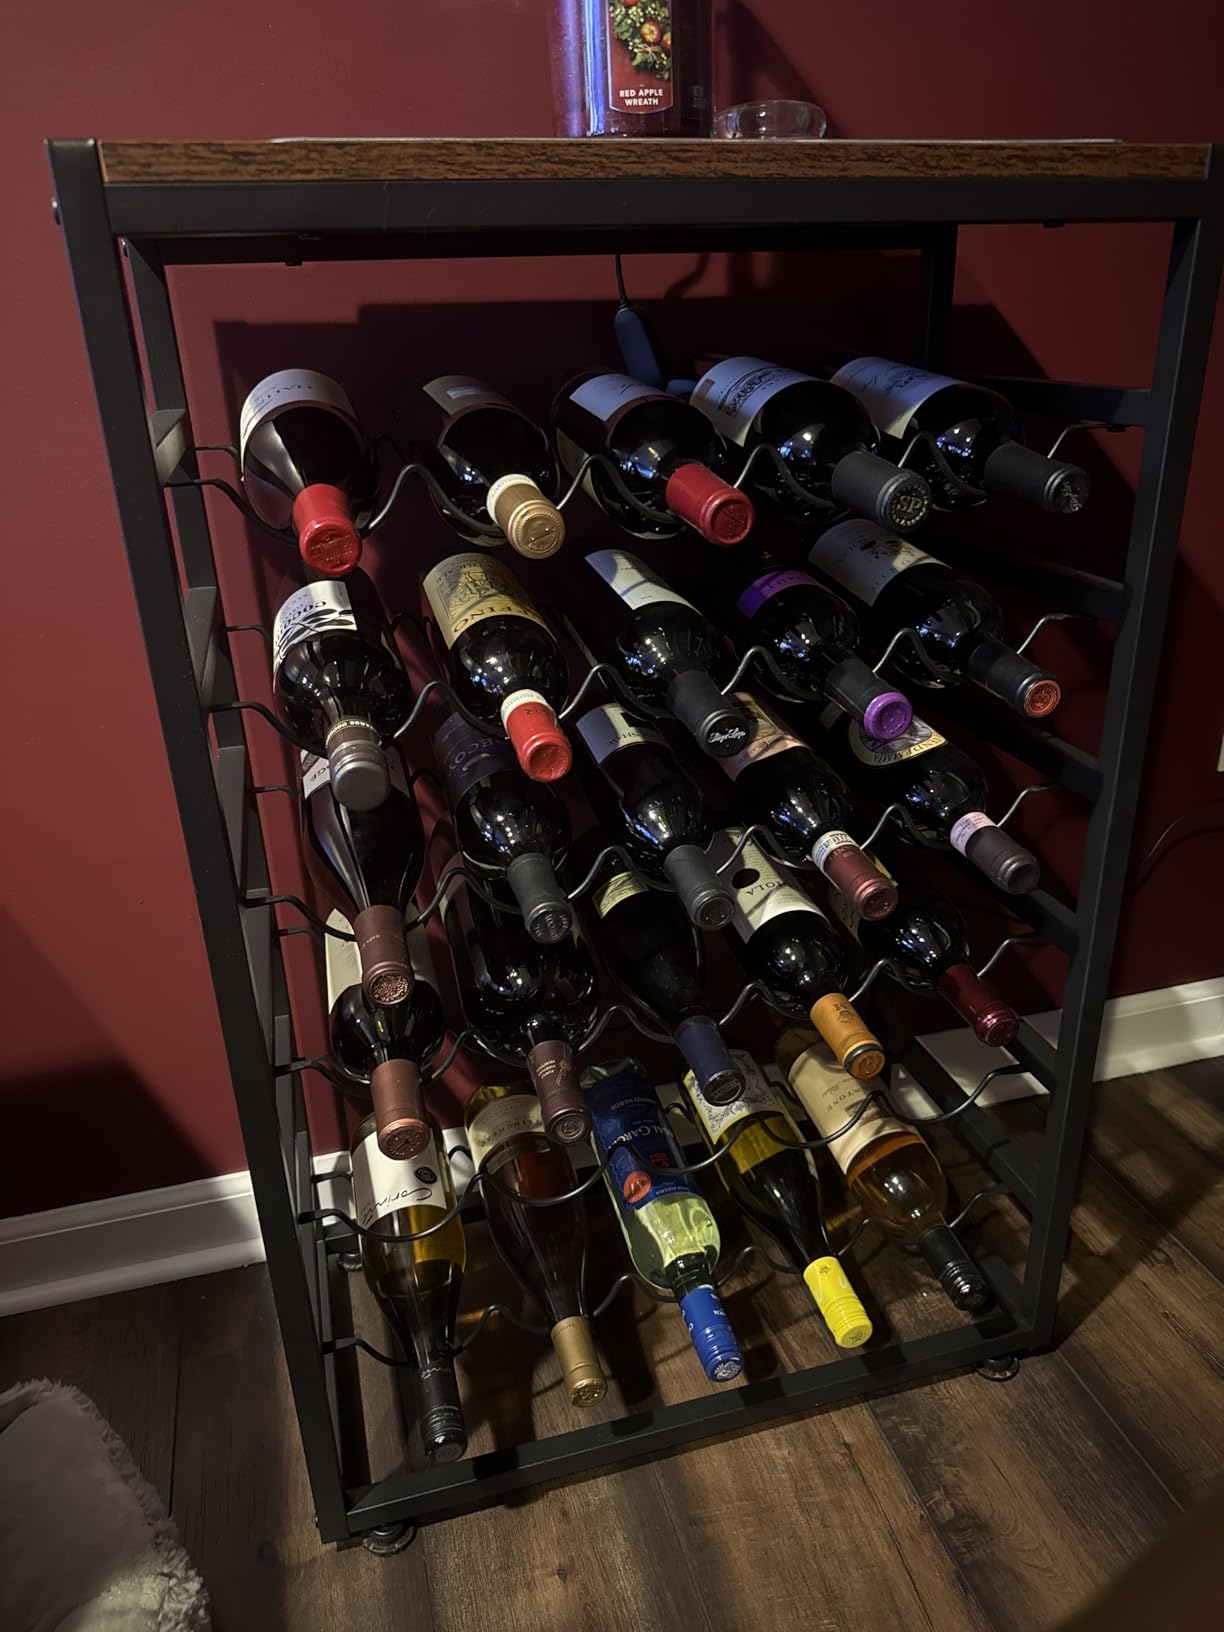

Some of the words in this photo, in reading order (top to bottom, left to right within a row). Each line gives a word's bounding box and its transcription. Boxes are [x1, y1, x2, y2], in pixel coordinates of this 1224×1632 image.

[619, 89, 636, 98] RED
[638, 88, 664, 97] APPLE
[624, 97, 659, 106] WREATH
